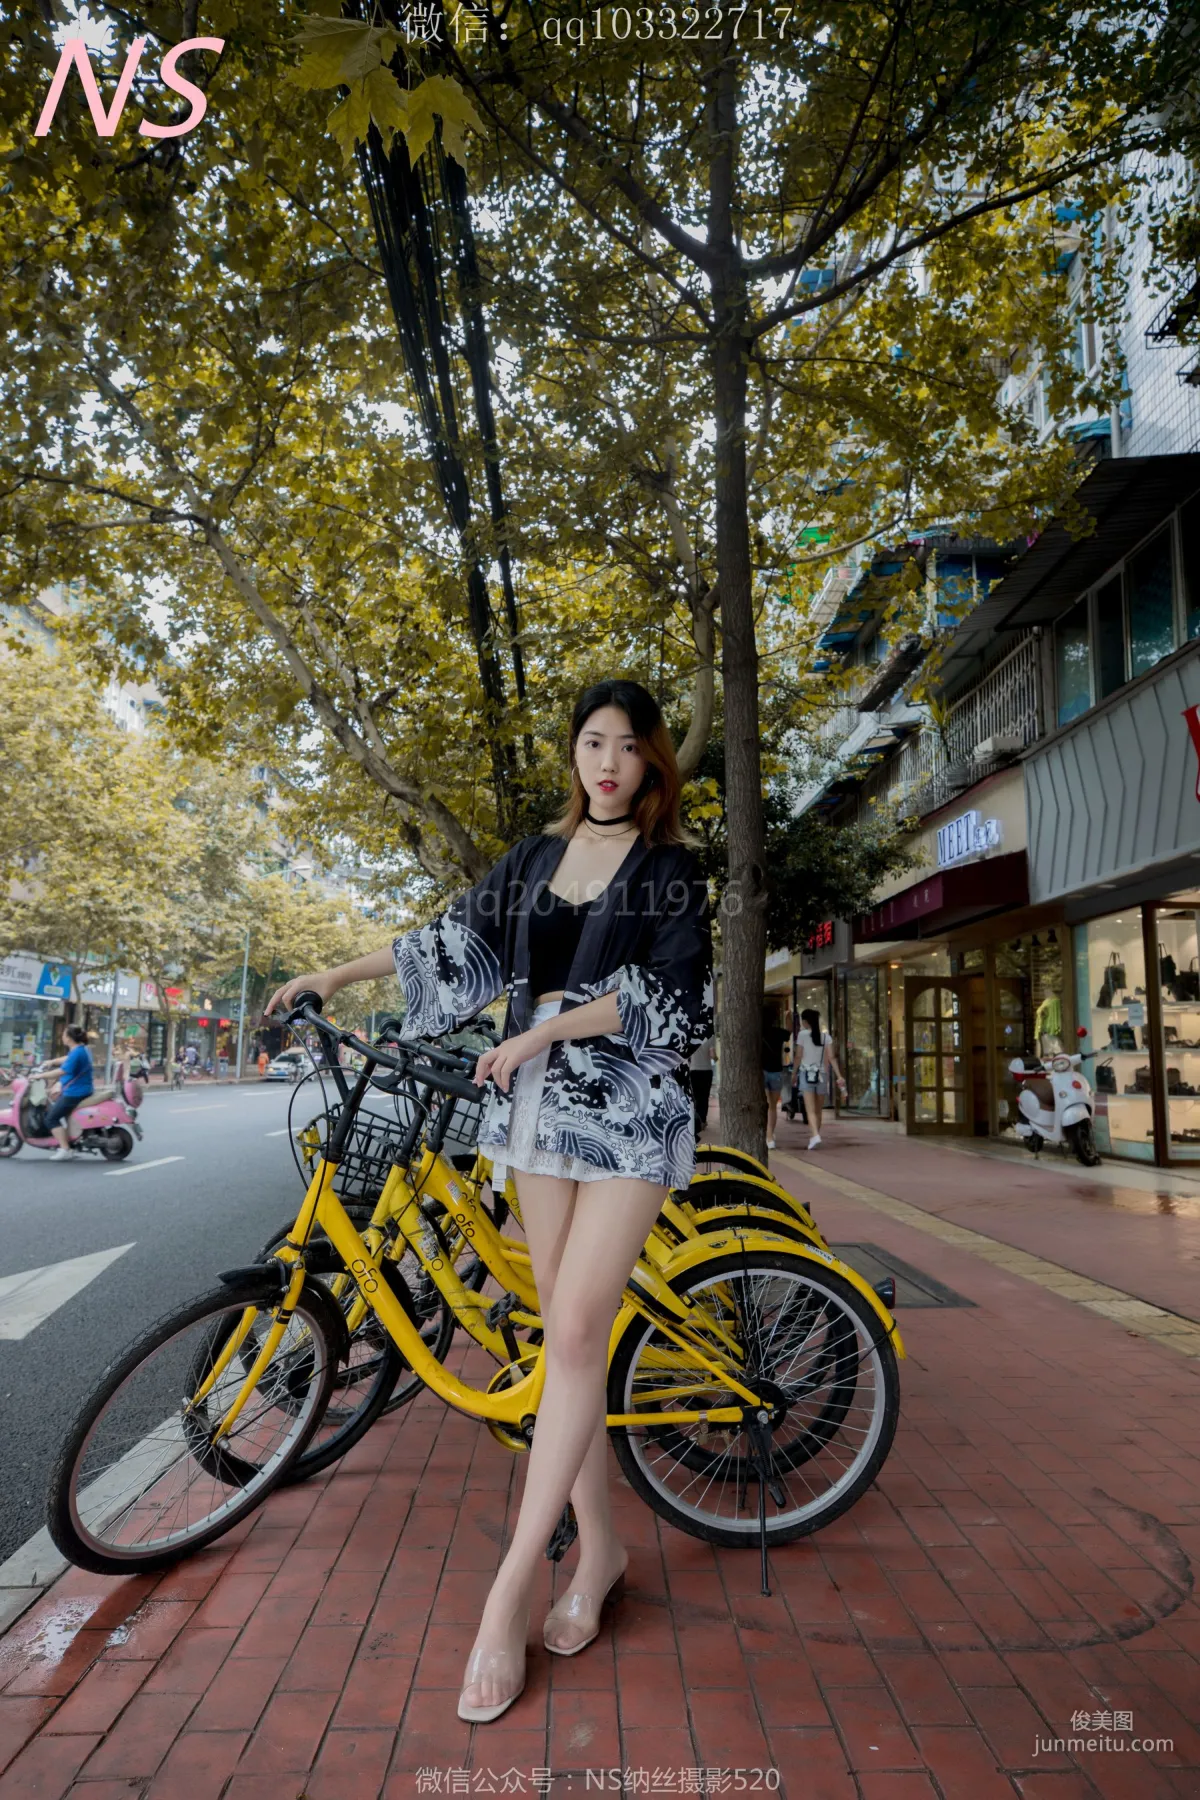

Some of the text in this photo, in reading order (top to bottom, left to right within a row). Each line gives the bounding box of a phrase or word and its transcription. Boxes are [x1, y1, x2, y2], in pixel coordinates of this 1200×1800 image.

[937, 812, 971, 866] MEET
[455, 1213, 475, 1238] ofo
[351, 1258, 379, 1293] ofo
